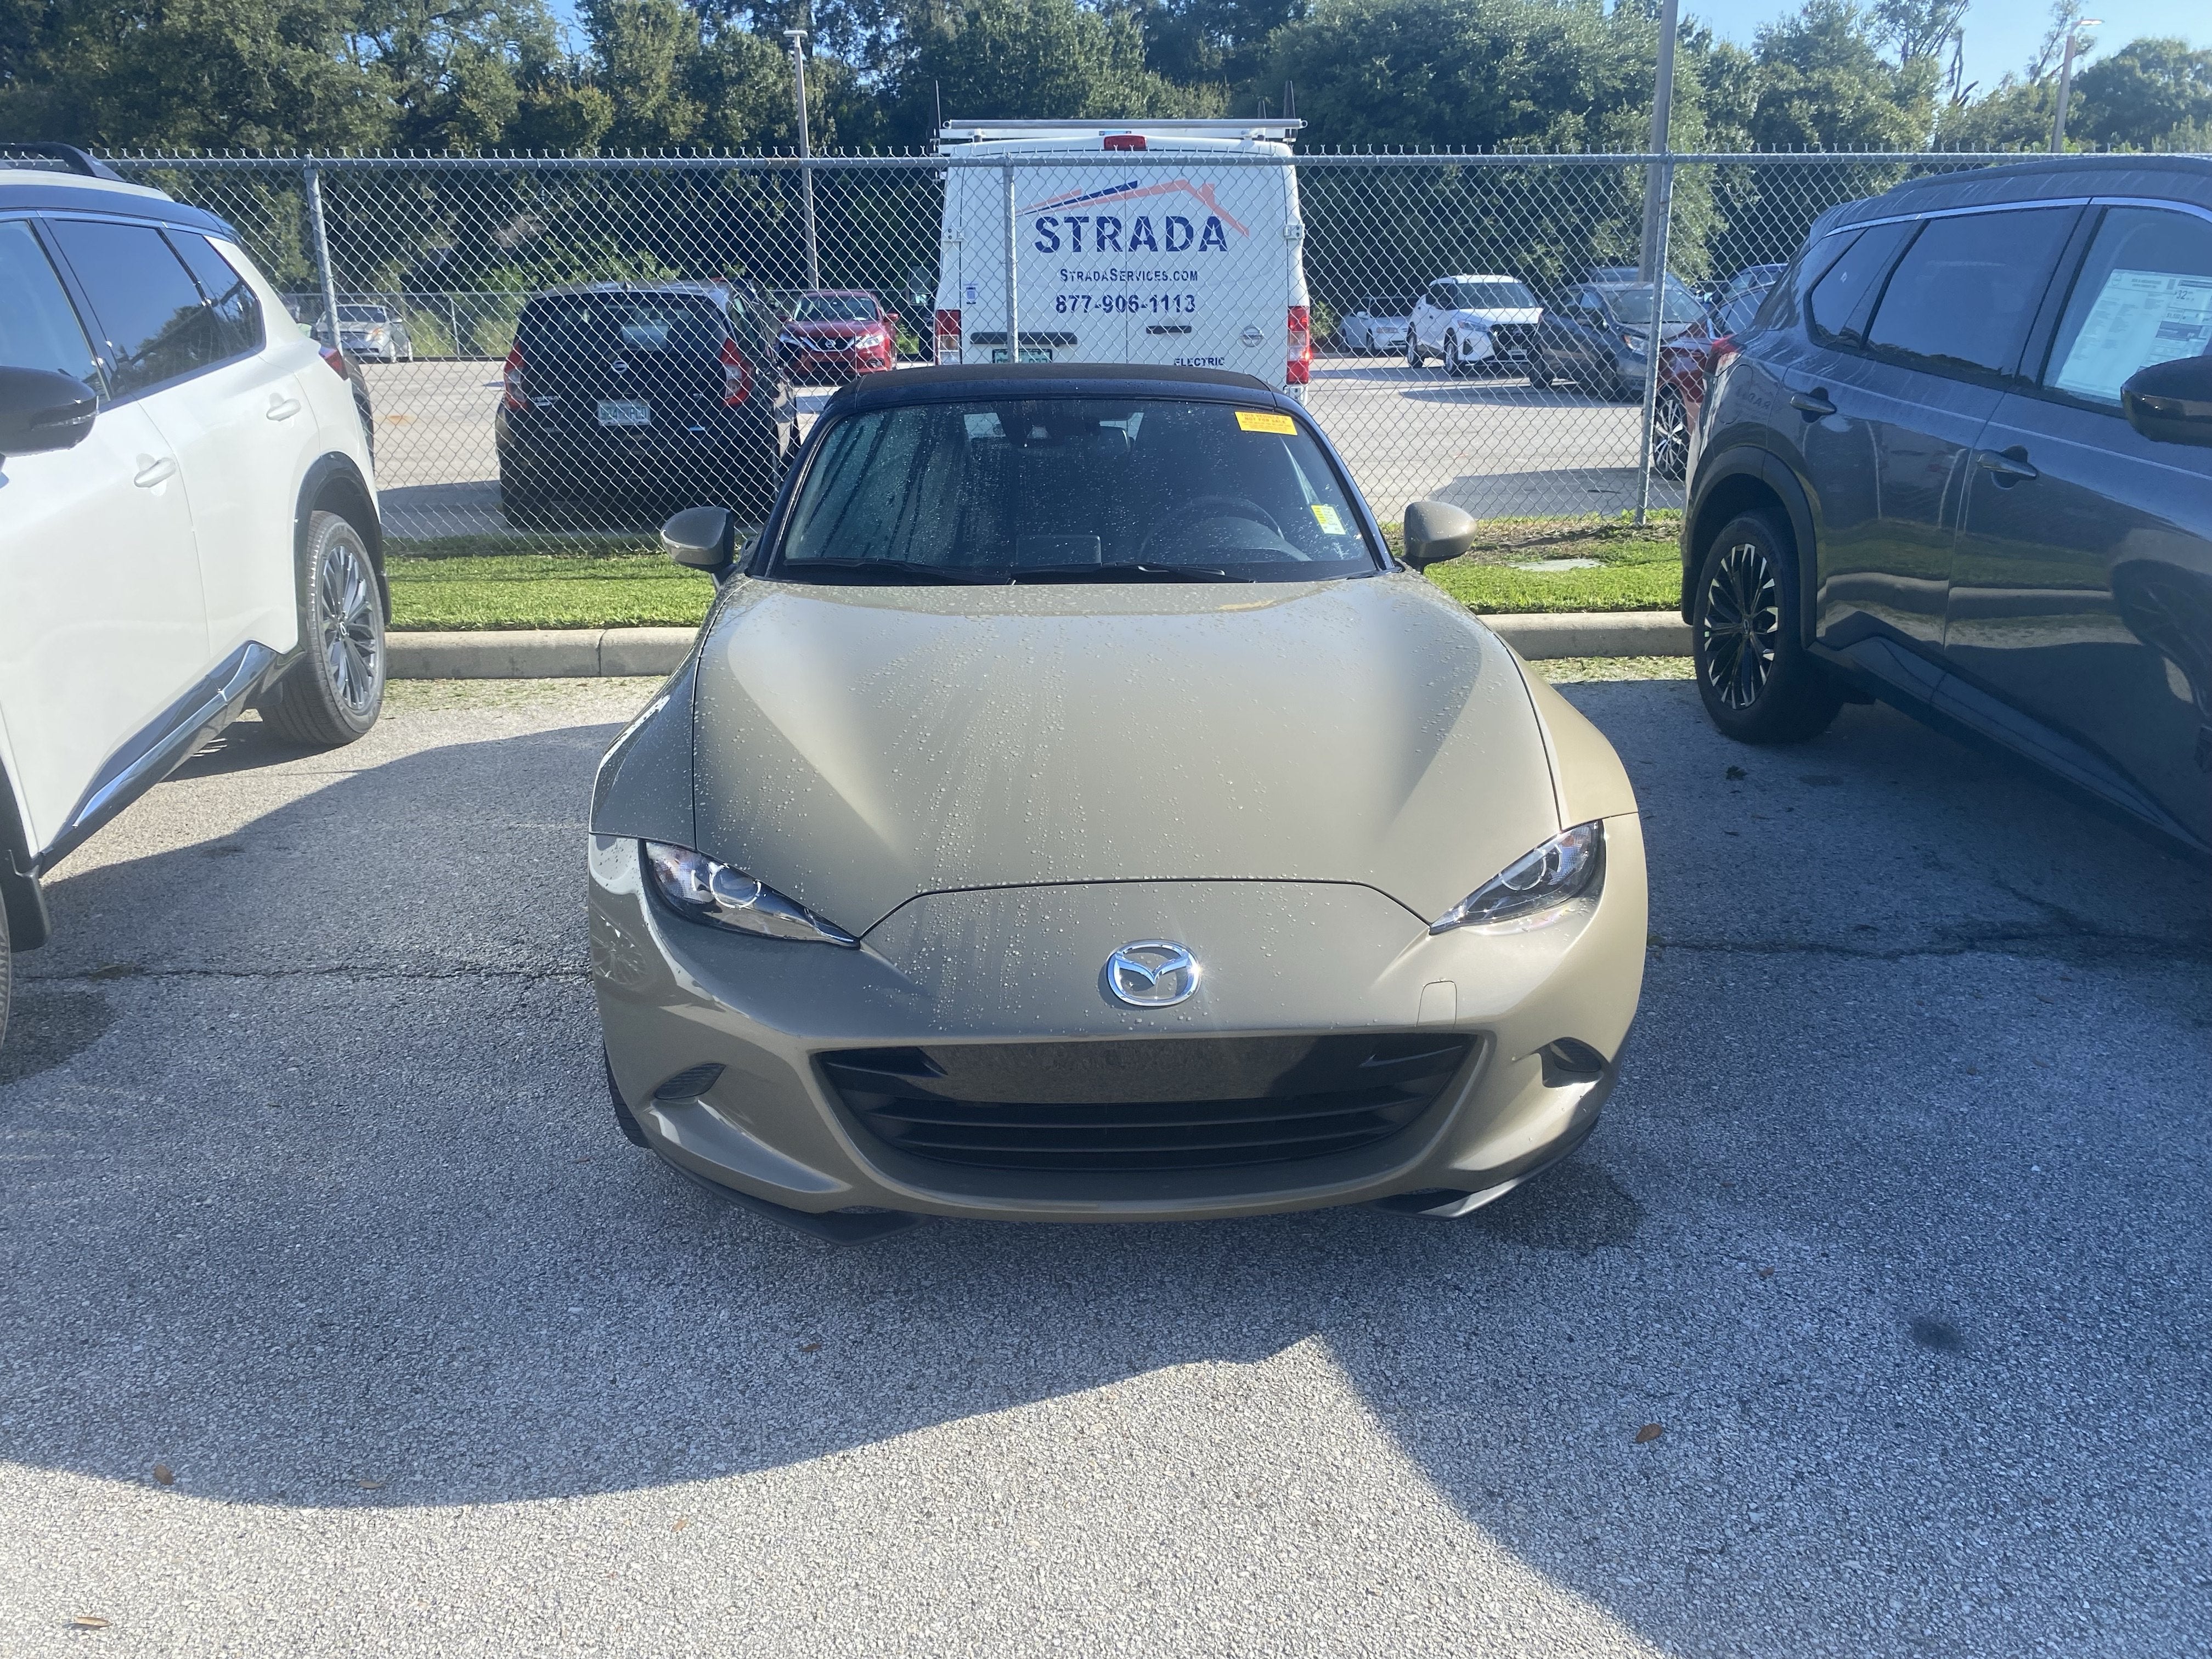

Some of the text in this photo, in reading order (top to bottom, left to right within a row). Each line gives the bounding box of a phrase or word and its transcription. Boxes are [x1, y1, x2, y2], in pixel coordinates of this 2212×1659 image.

[1035, 216, 1228, 253] STRADA
[1056, 294, 1196, 313] 877-906-1113
[1174, 357, 1225, 366] ELECTRIC
